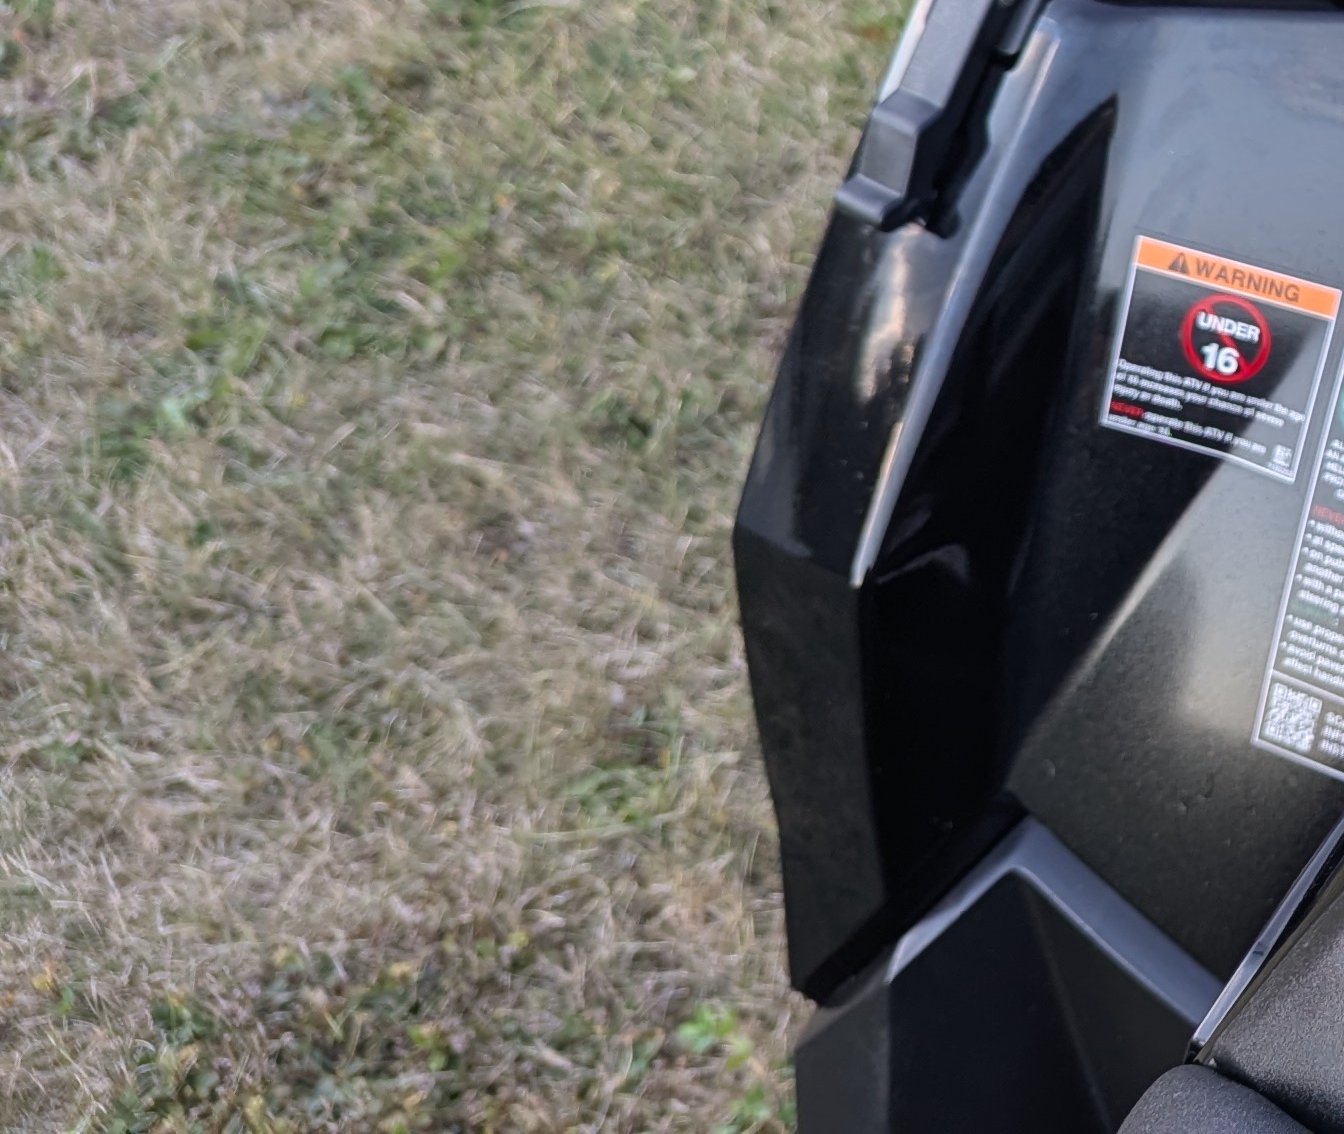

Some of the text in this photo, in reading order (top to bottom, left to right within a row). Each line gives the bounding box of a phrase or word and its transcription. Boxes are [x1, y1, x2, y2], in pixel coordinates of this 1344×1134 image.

[1193, 257, 1302, 303] WARNING
[1195, 310, 1261, 344] UNDER
[1198, 340, 1241, 377] 16
